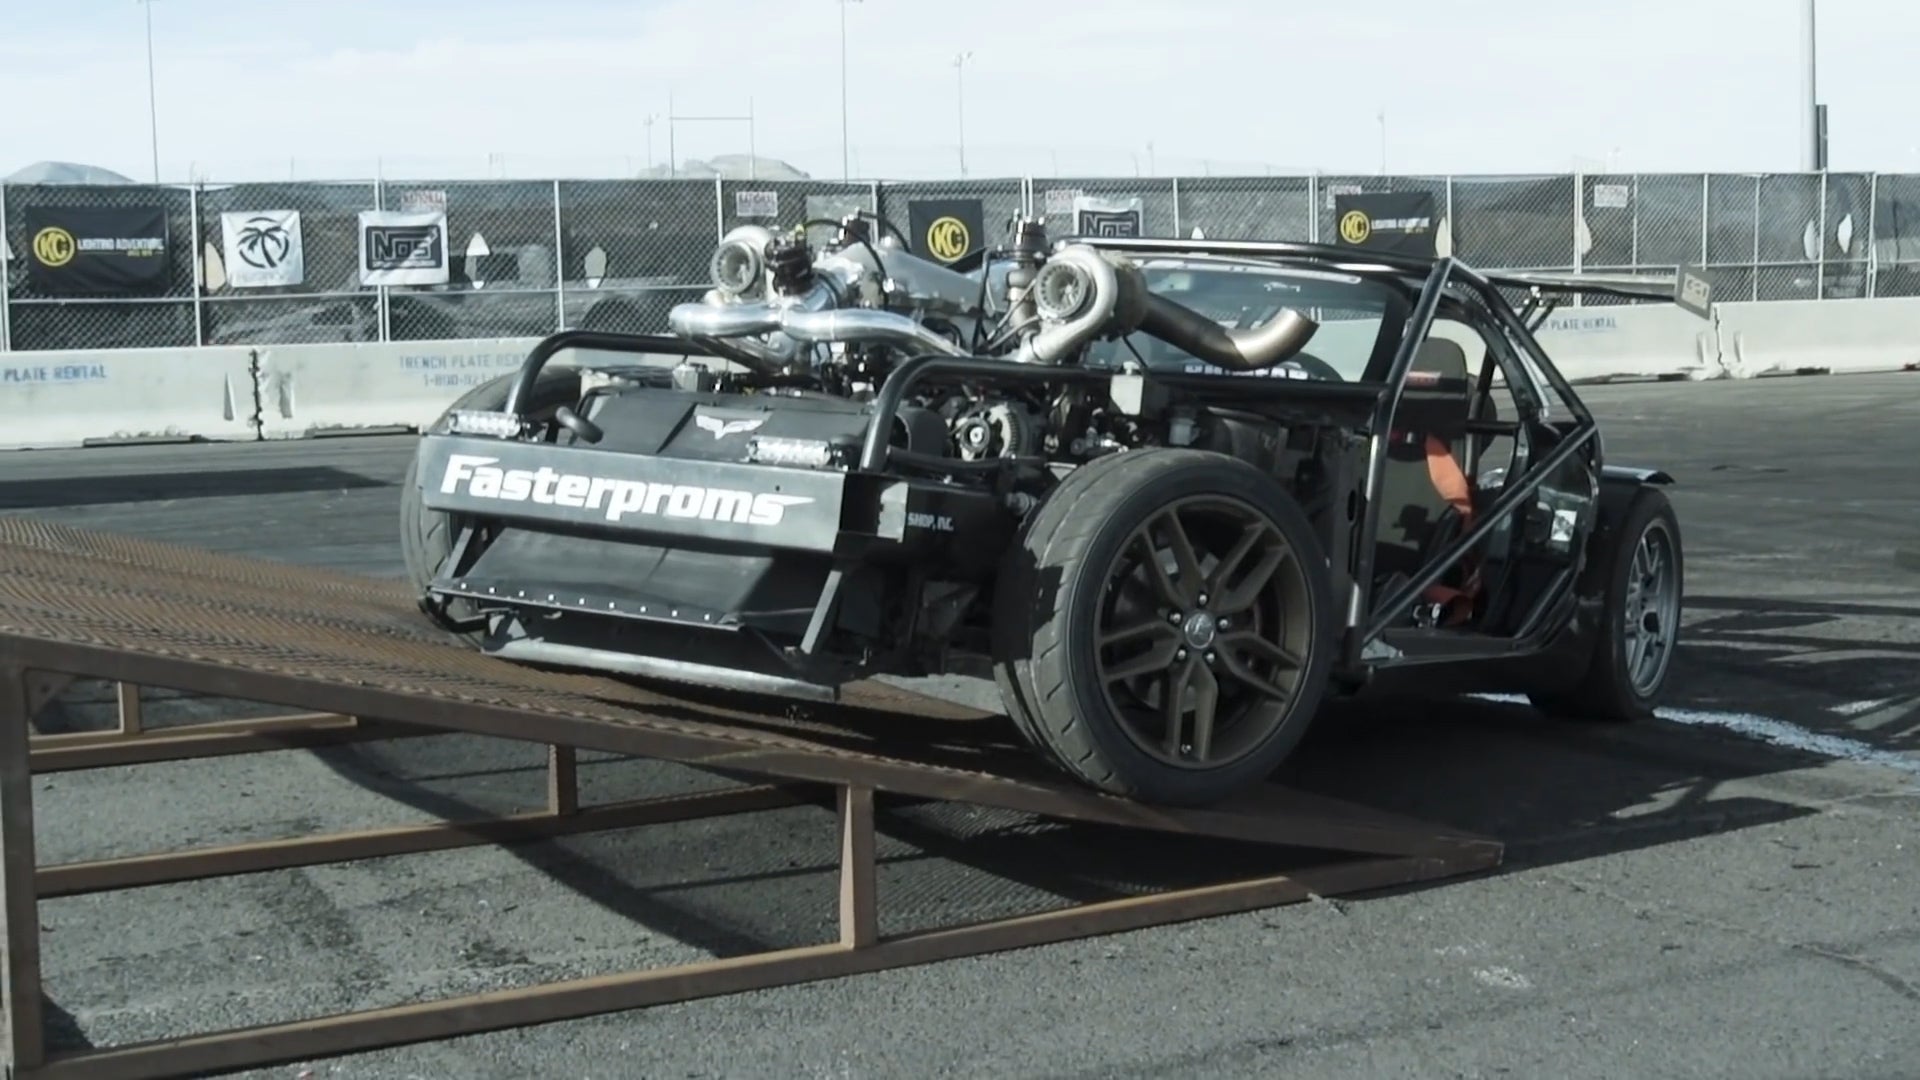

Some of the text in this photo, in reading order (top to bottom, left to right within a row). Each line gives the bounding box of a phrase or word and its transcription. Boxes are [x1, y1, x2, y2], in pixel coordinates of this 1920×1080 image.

[40, 232, 68, 260] KC
[371, 230, 434, 260] NOS
[933, 222, 963, 254] KC
[4, 364, 107, 381] PLATE RENTAL
[451, 354, 490, 368] PLATE
[440, 454, 816, 526] Fasterproms
